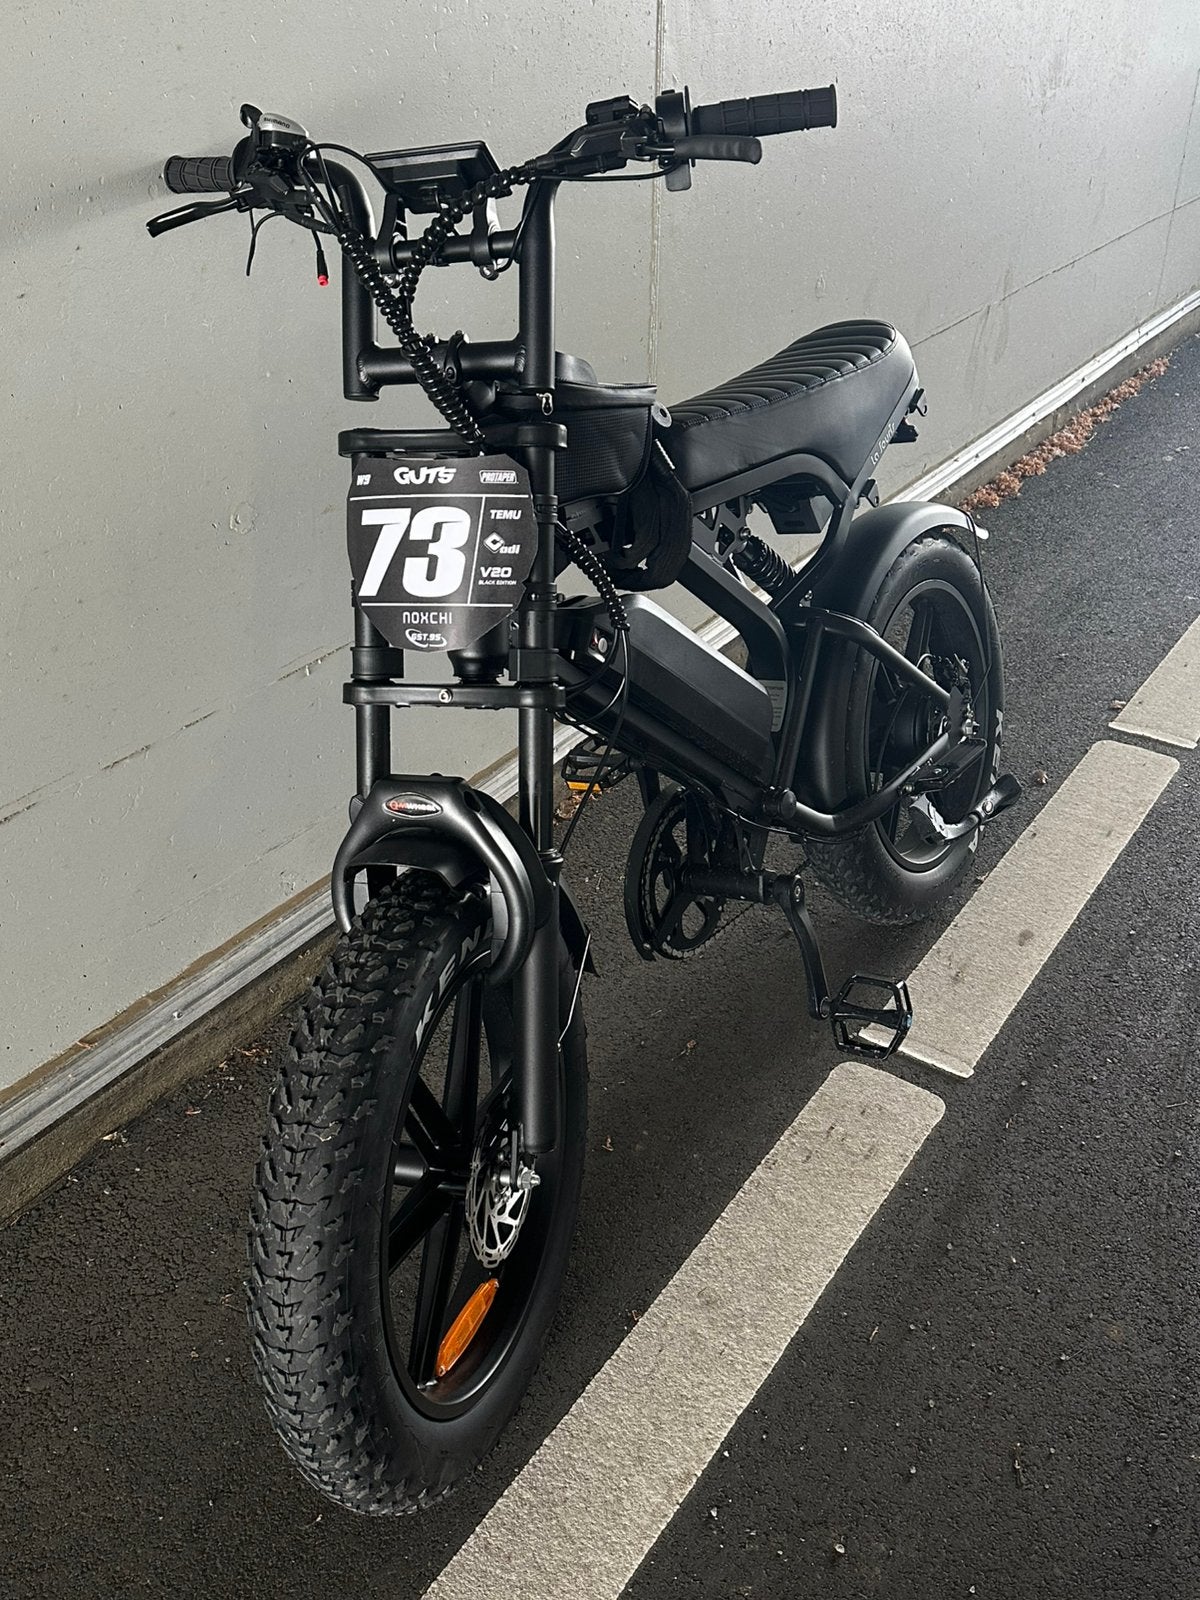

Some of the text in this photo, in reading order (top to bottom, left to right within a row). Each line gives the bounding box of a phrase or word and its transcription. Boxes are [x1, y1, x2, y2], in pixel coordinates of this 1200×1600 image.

[393, 466, 456, 484] GUTS
[479, 471, 516, 483] PROTAPER
[489, 509, 522, 520] TEMU
[358, 505, 471, 597] 73
[479, 566, 512, 577] V20
[402, 611, 453, 625] NOXCHI
